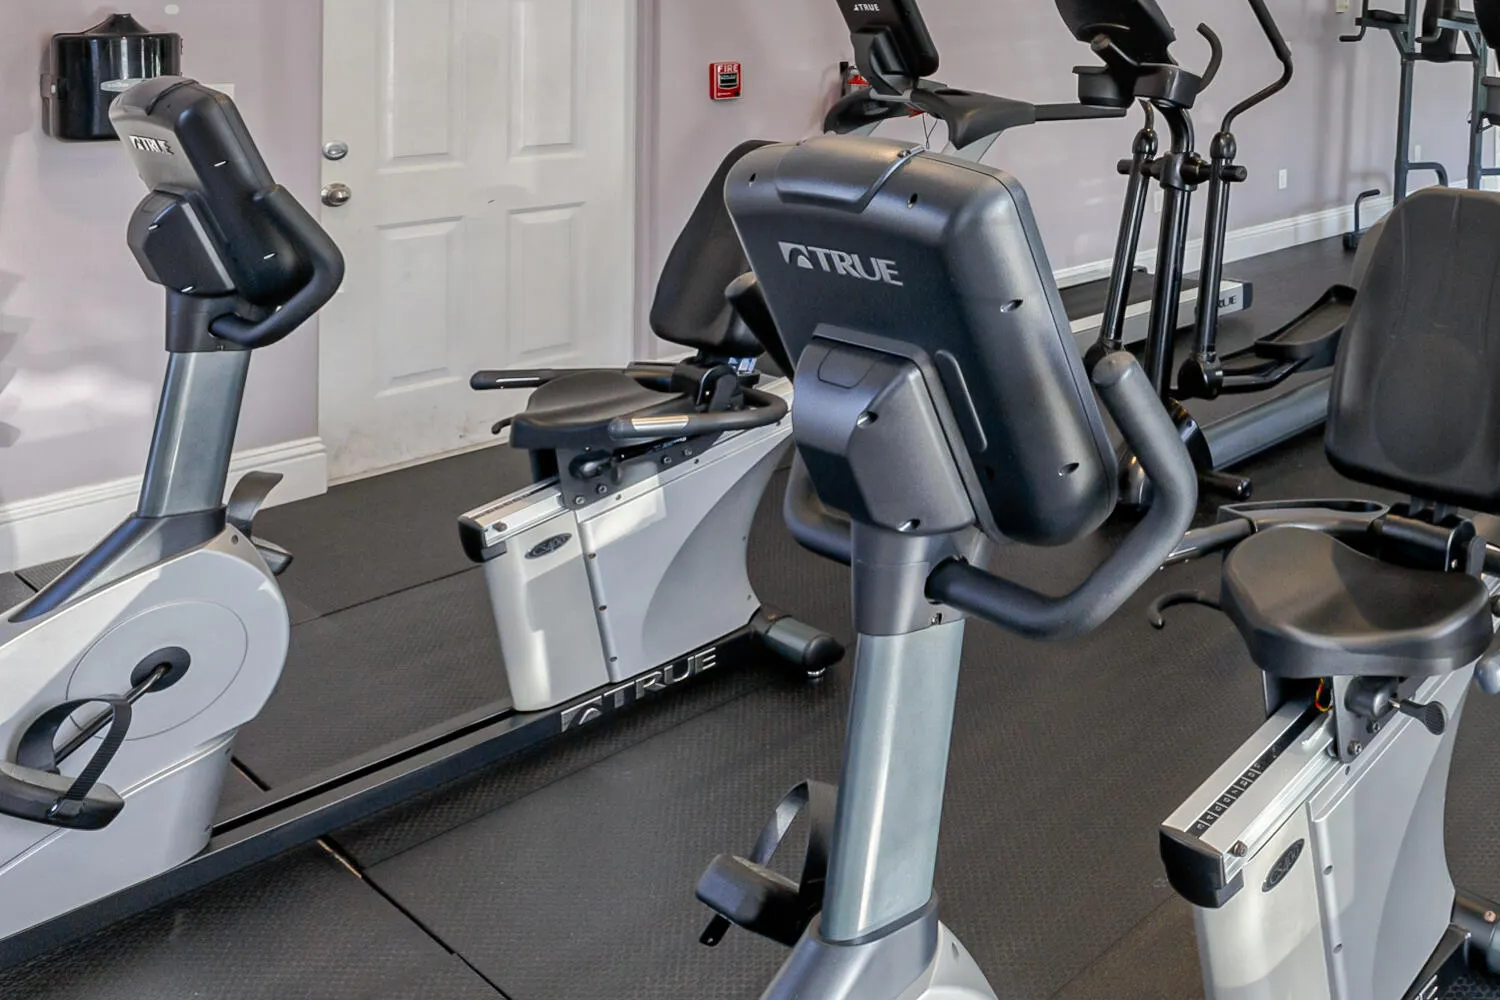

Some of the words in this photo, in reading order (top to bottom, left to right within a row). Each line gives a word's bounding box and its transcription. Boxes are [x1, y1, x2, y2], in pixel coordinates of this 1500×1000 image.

[858, 3, 880, 11] TRUE
[717, 64, 738, 73] FIRE
[807, 246, 903, 286] TRUE
[604, 647, 716, 709] TRUE
